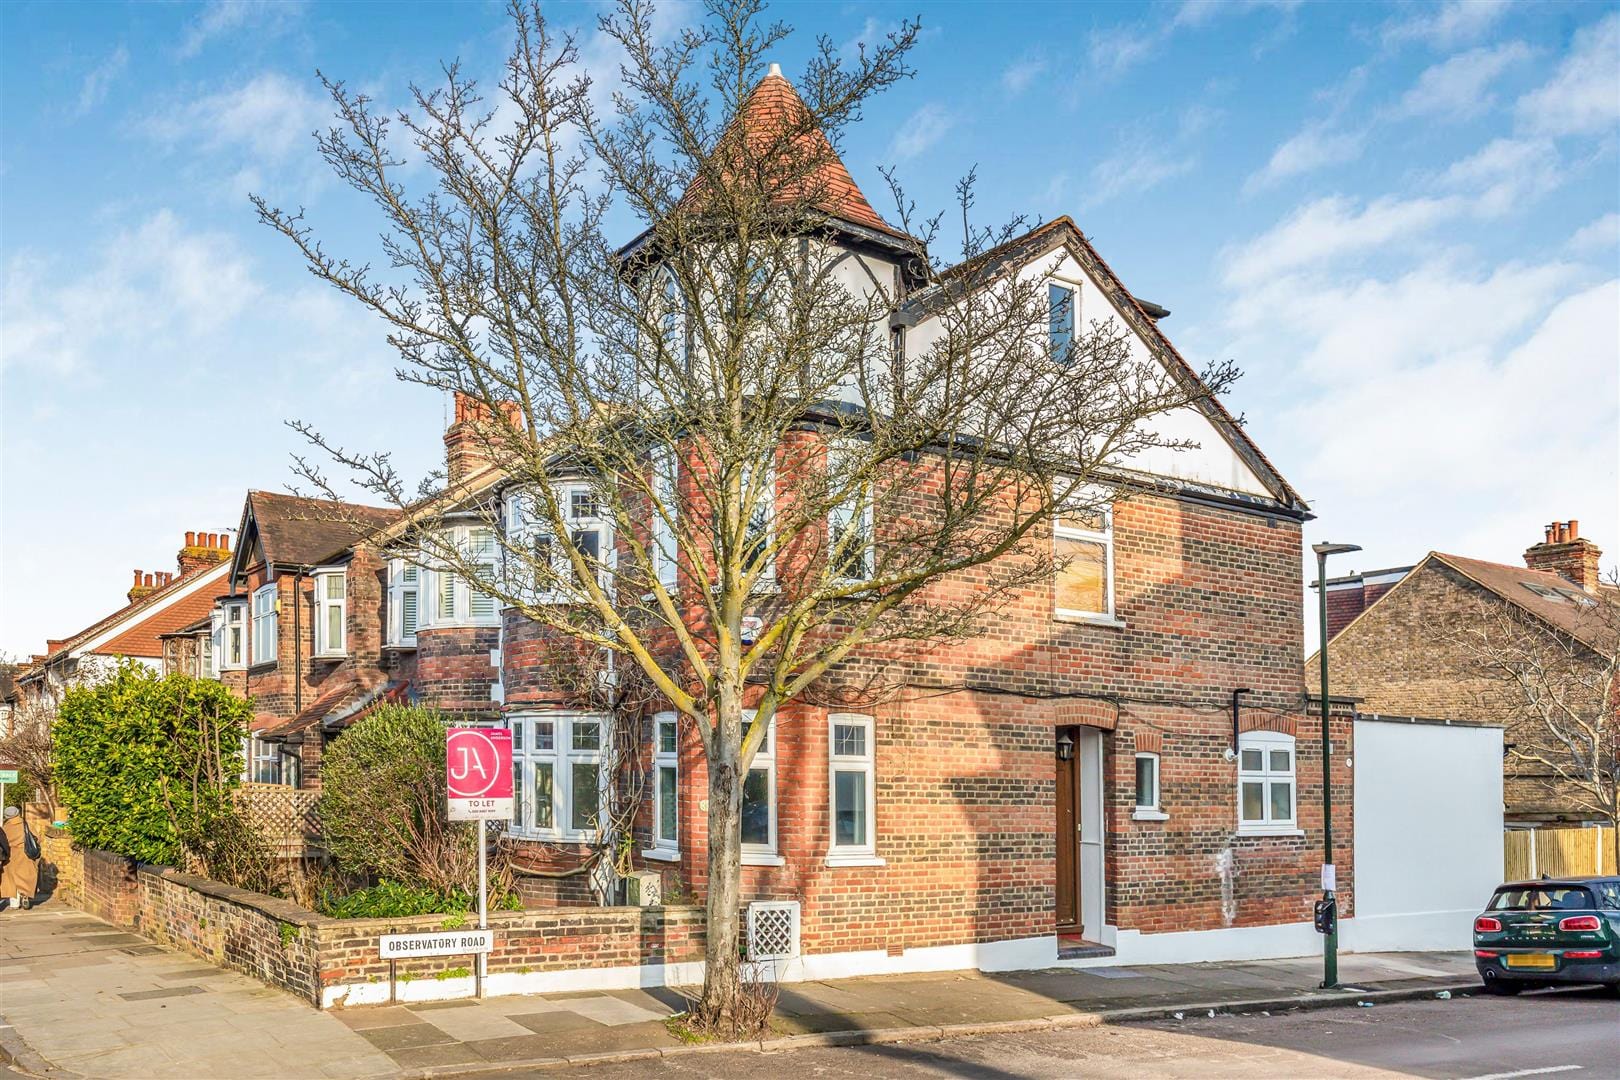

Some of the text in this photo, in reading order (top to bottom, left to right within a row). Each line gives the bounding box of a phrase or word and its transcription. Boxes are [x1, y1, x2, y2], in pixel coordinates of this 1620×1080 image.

[450, 747, 487, 780] JA
[389, 938, 457, 951] OBSERVATORY
[461, 937, 485, 947] ROAD
